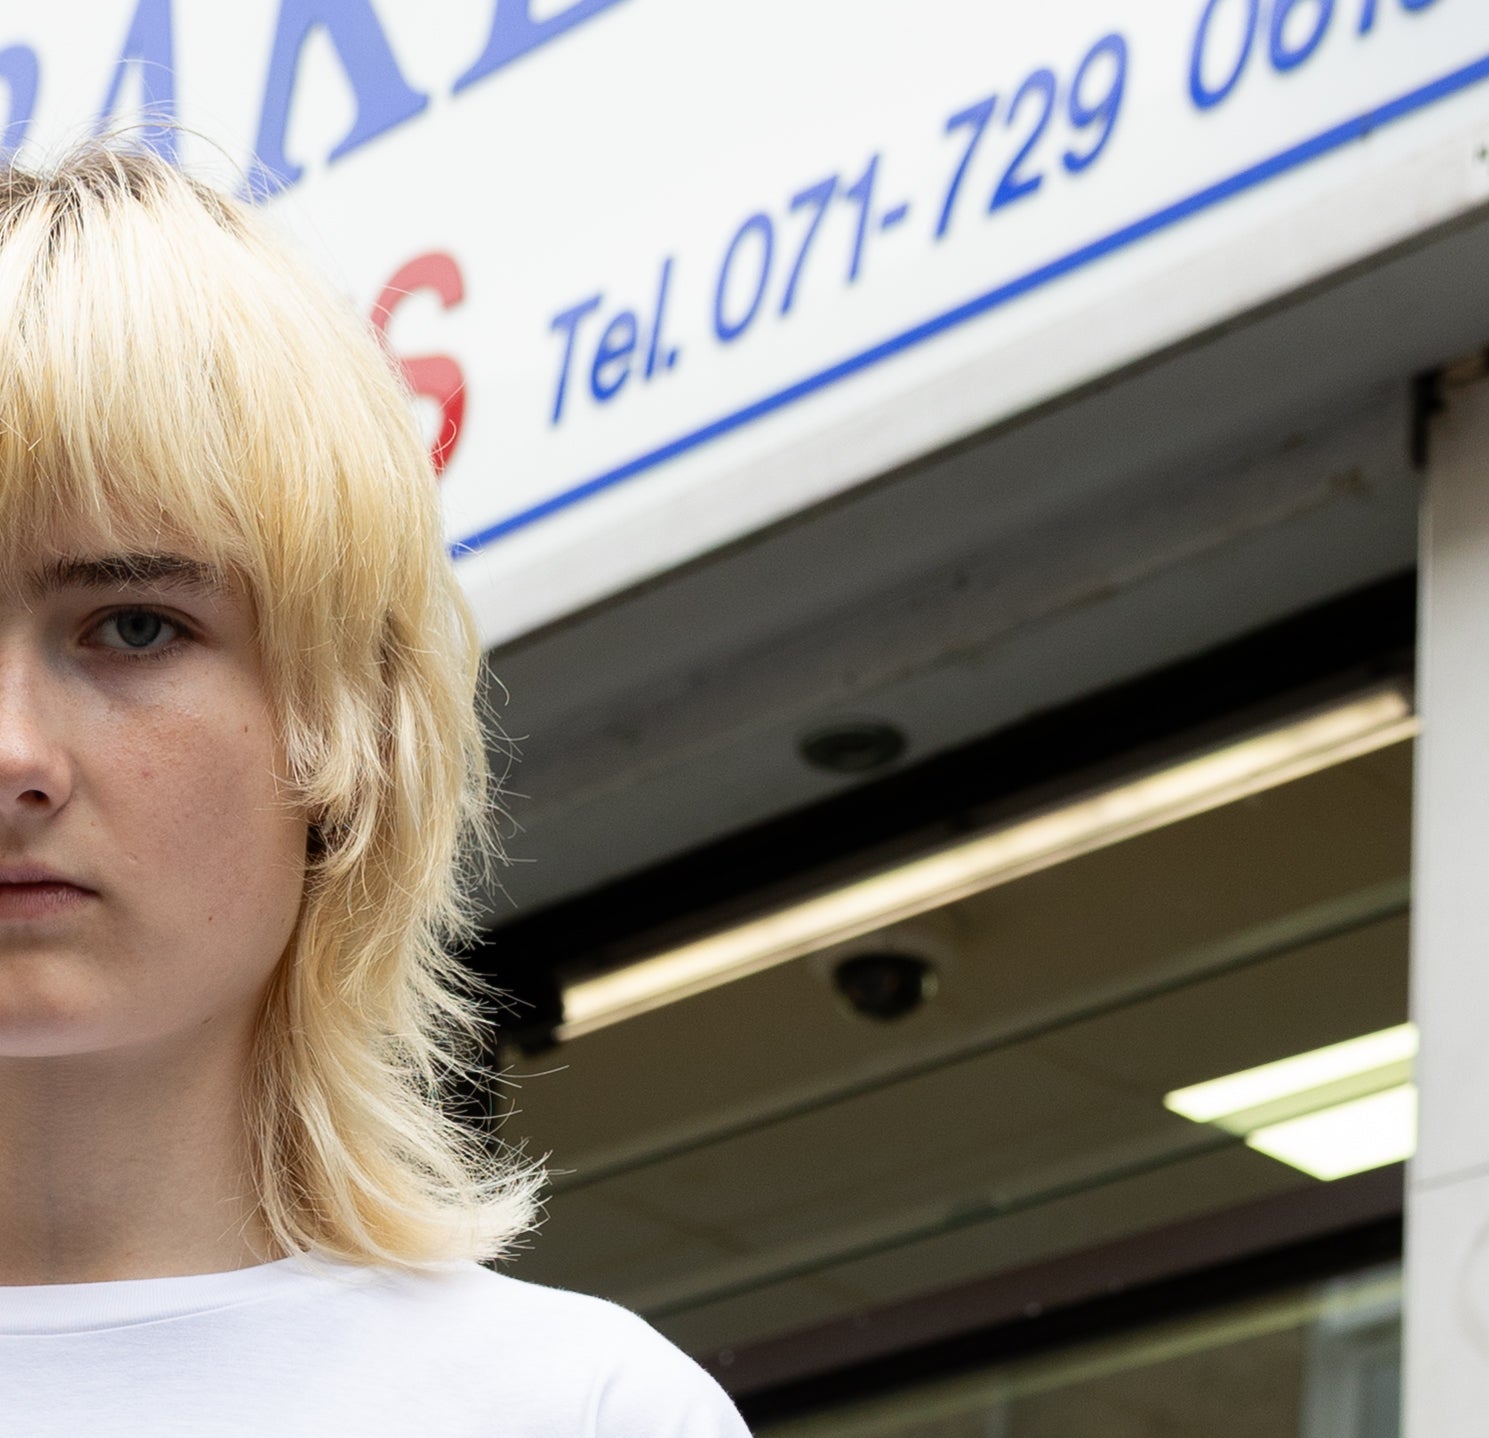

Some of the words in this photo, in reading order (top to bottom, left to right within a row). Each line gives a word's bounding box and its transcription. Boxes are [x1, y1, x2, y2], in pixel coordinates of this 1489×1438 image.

[548, 256, 680, 427] Tel.
[711, 30, 1131, 346] 071-729
[1185, 0, 1438, 113] 06
